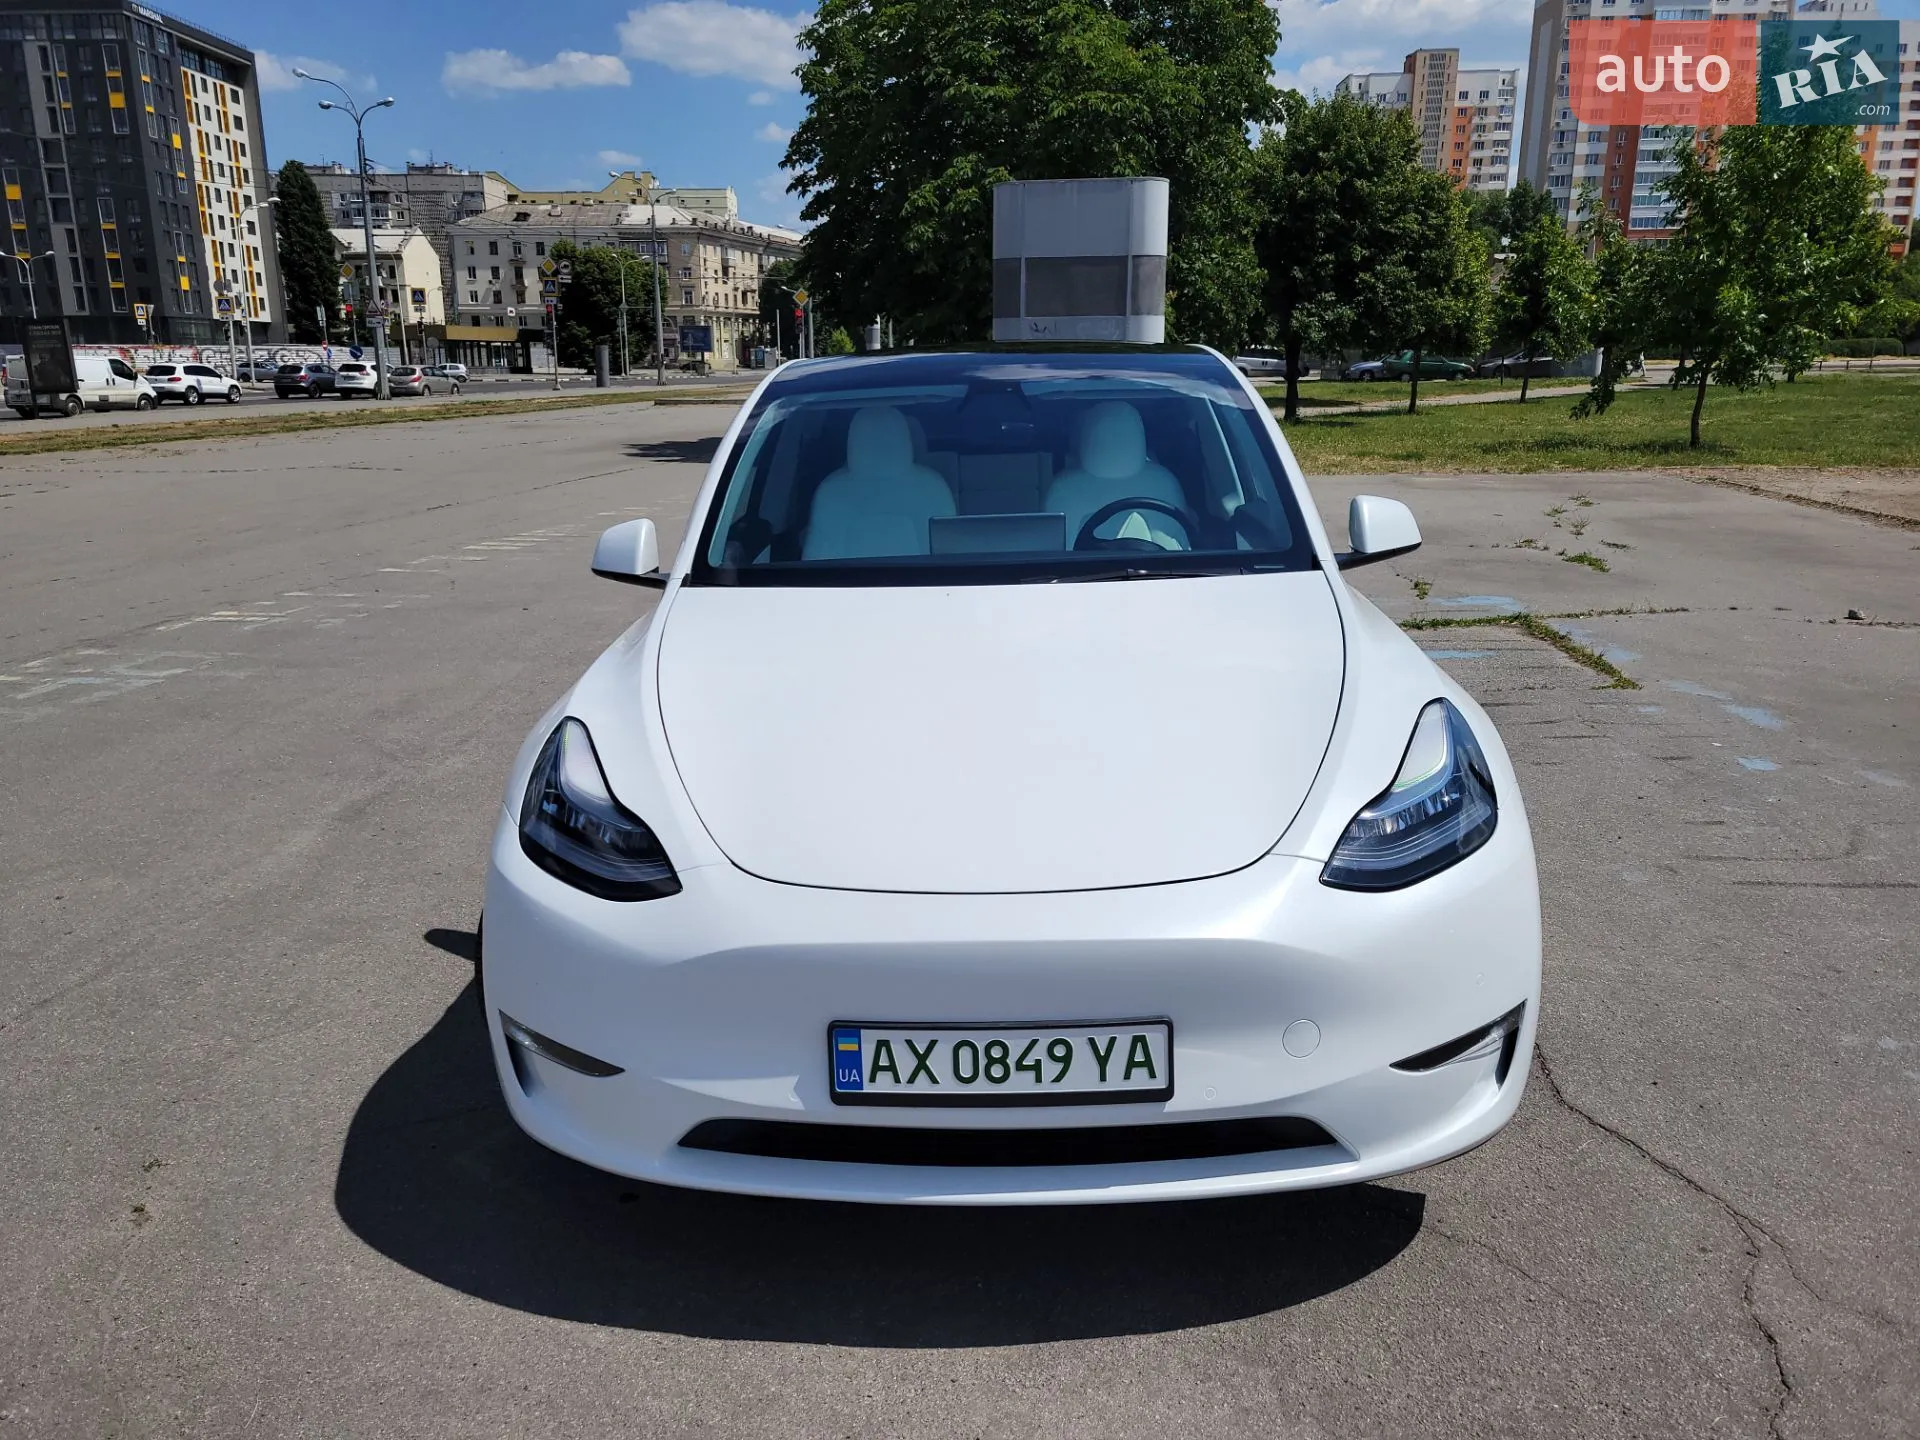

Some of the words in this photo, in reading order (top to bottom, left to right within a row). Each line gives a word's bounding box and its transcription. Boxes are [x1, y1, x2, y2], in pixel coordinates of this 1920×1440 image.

[839, 1068, 860, 1083] UA
[868, 1038, 941, 1085] AX
[952, 1037, 1074, 1084] 0849
[1087, 1034, 1158, 1081] YA
